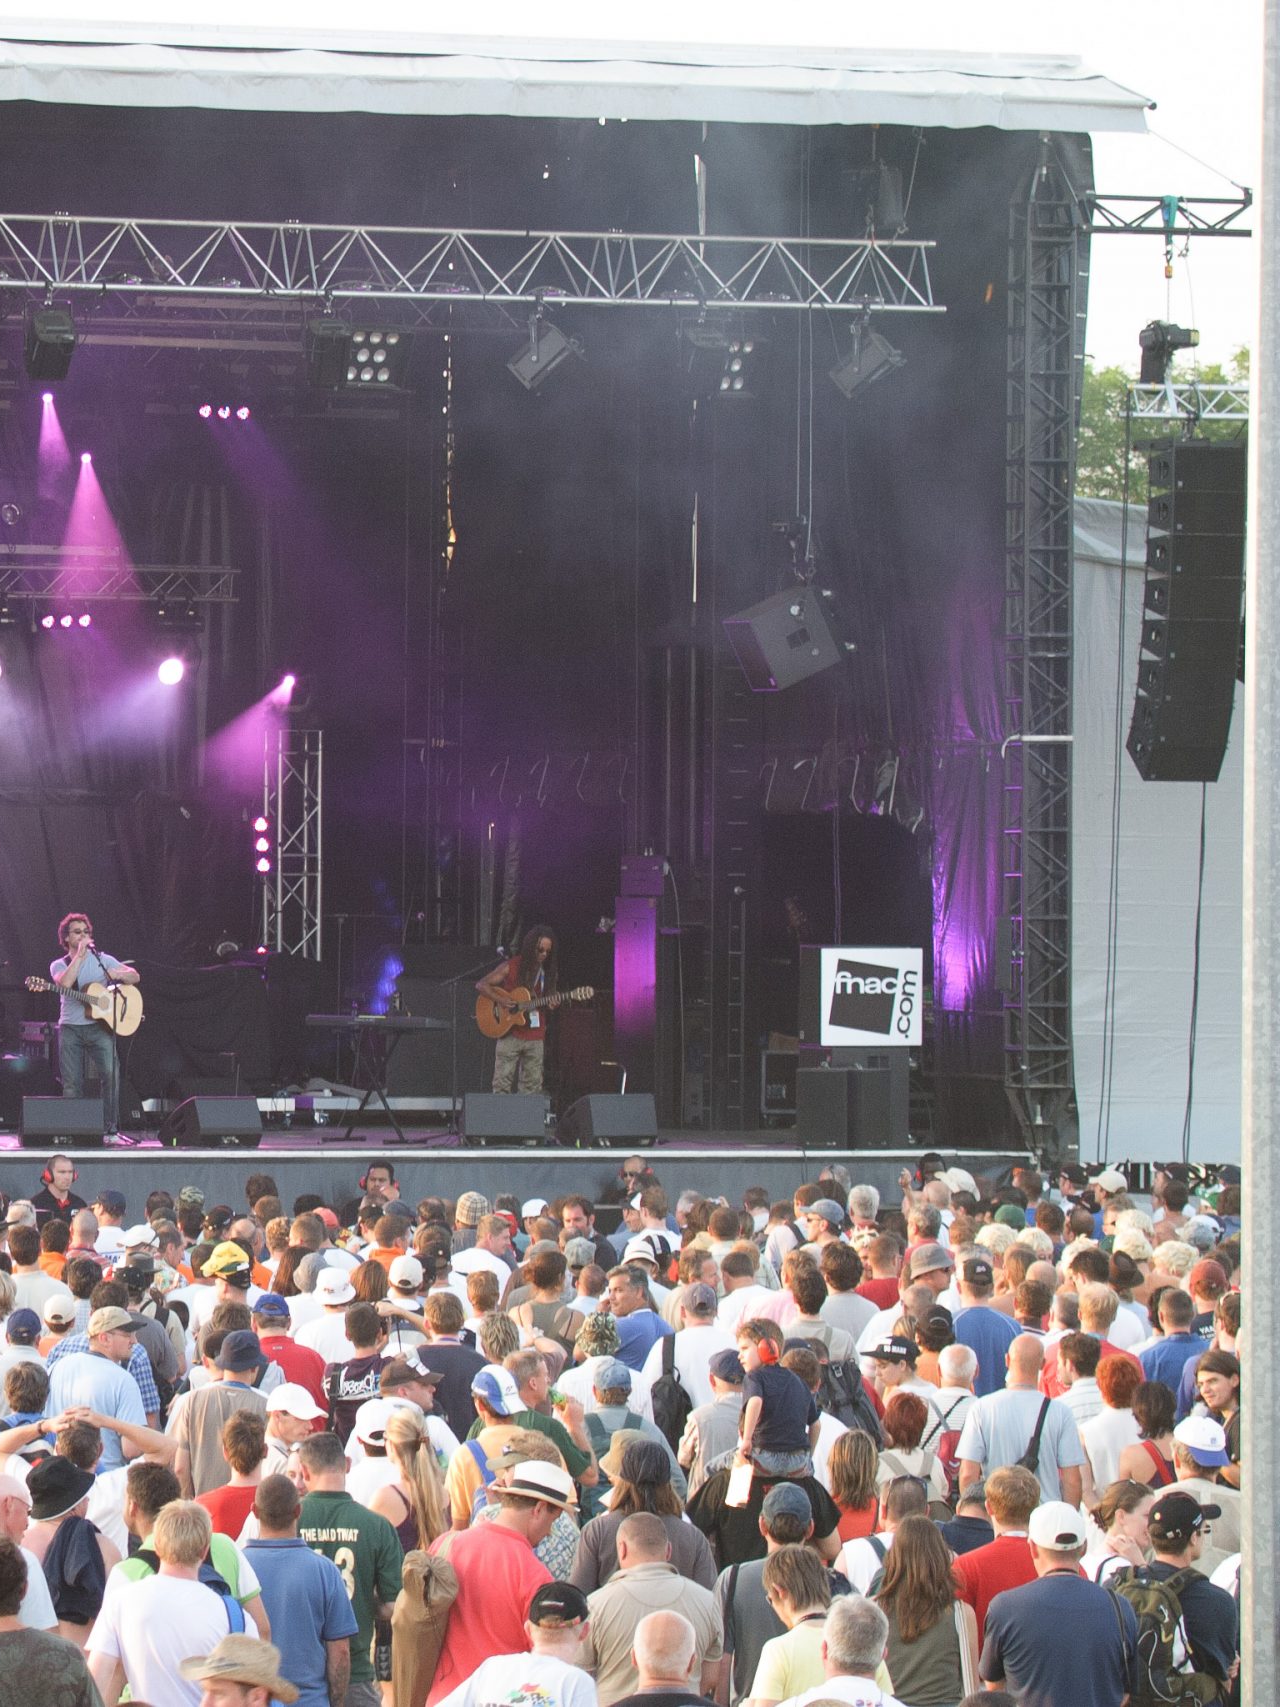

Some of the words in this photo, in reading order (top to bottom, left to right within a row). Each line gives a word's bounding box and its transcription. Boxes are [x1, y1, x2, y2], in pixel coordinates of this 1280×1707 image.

[834, 971, 898, 995] fnac
[897, 970, 918, 1039] .com
[300, 1528, 317, 1542] THE
[336, 1528, 359, 1542] TWAT
